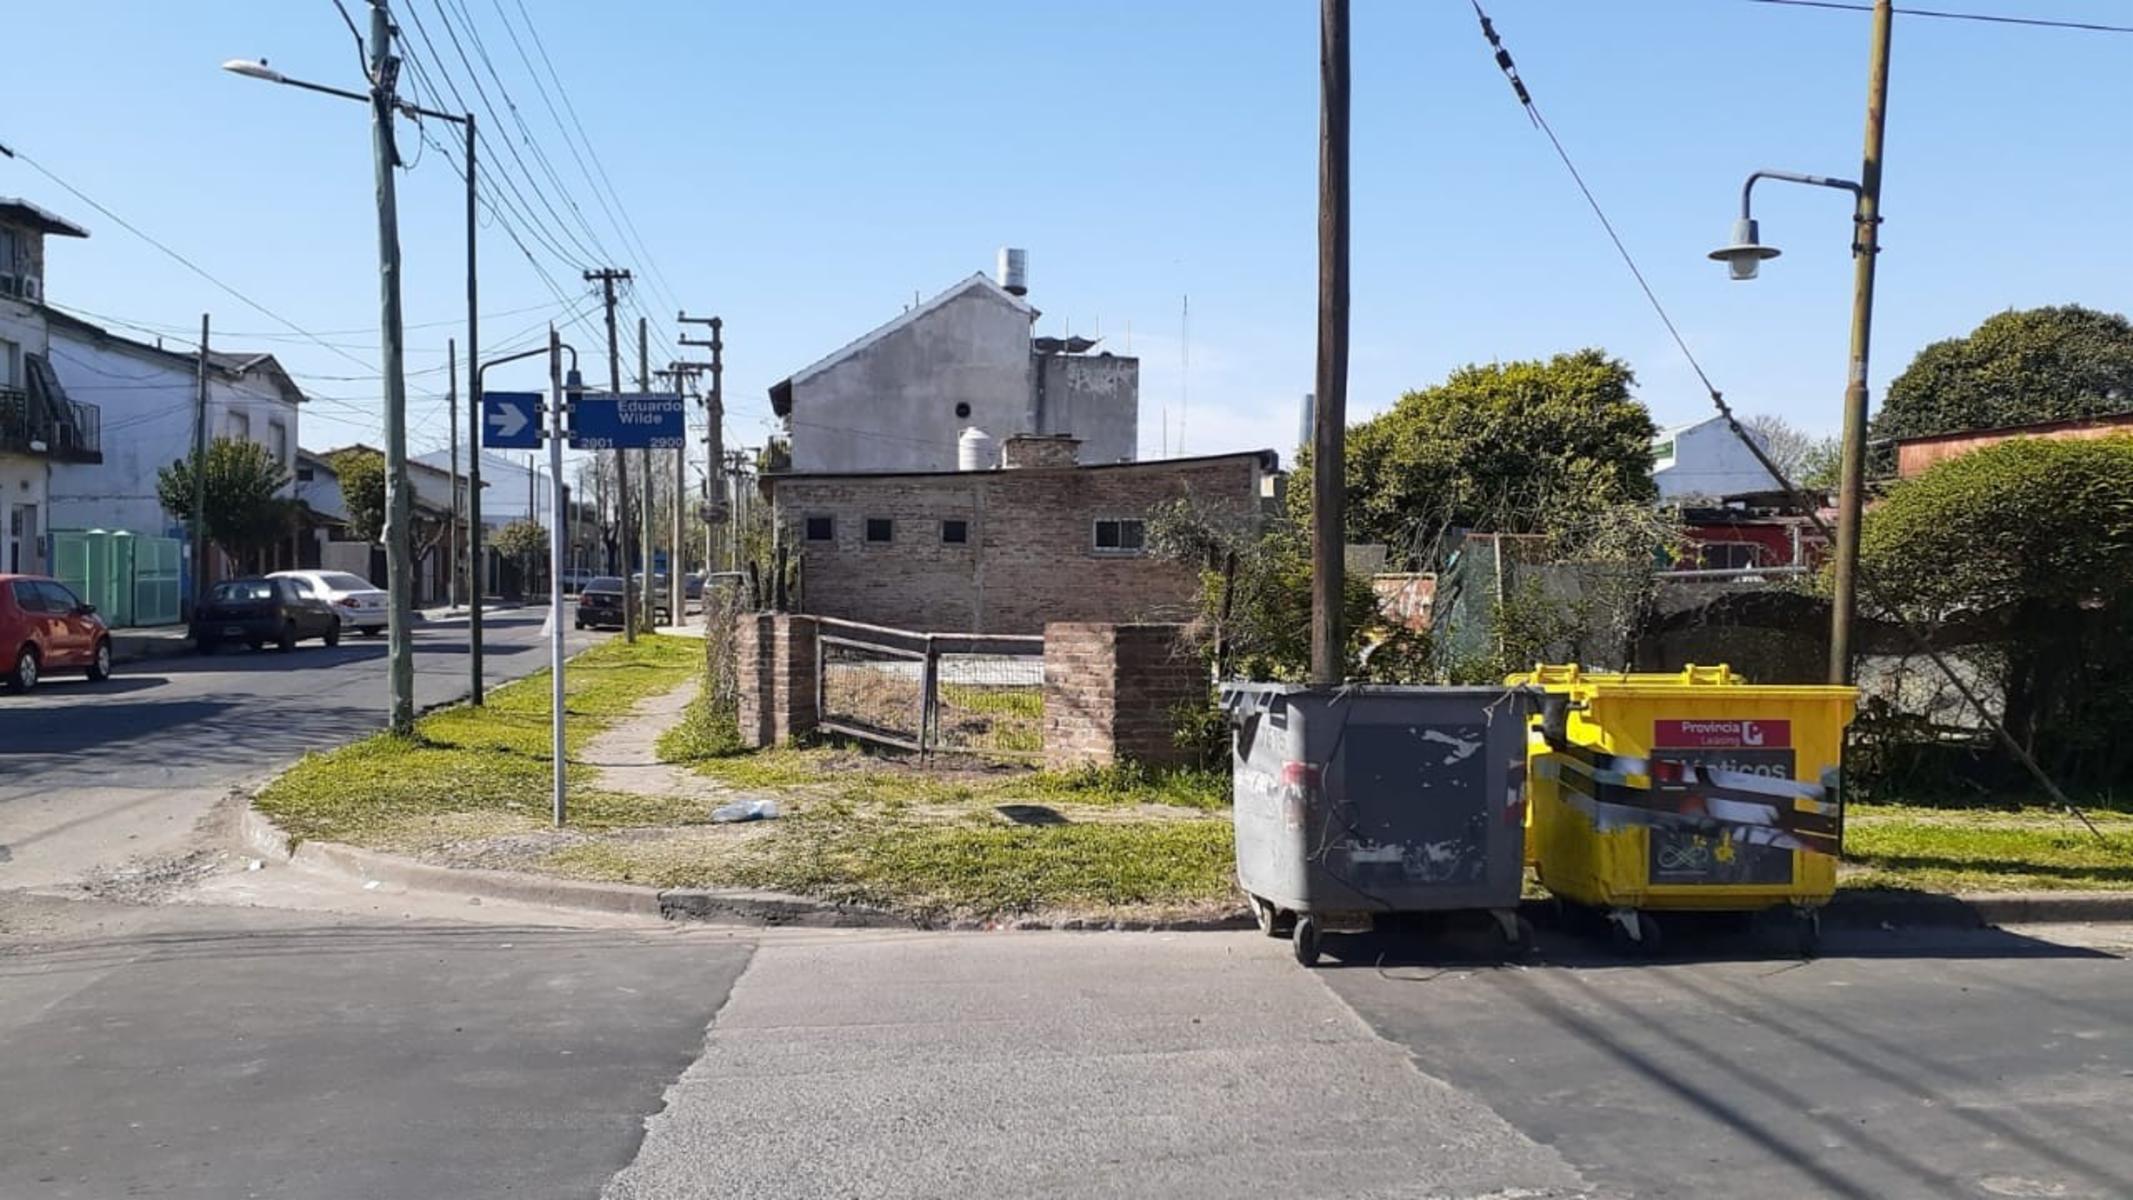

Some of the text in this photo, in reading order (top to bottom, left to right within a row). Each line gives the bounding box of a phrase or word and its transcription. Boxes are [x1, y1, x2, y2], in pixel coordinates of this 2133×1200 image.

[617, 400, 682, 412] Eduardo
[619, 413, 663, 425] Wilde
[650, 437, 684, 448] 2900
[1681, 721, 1740, 734] Provincia
